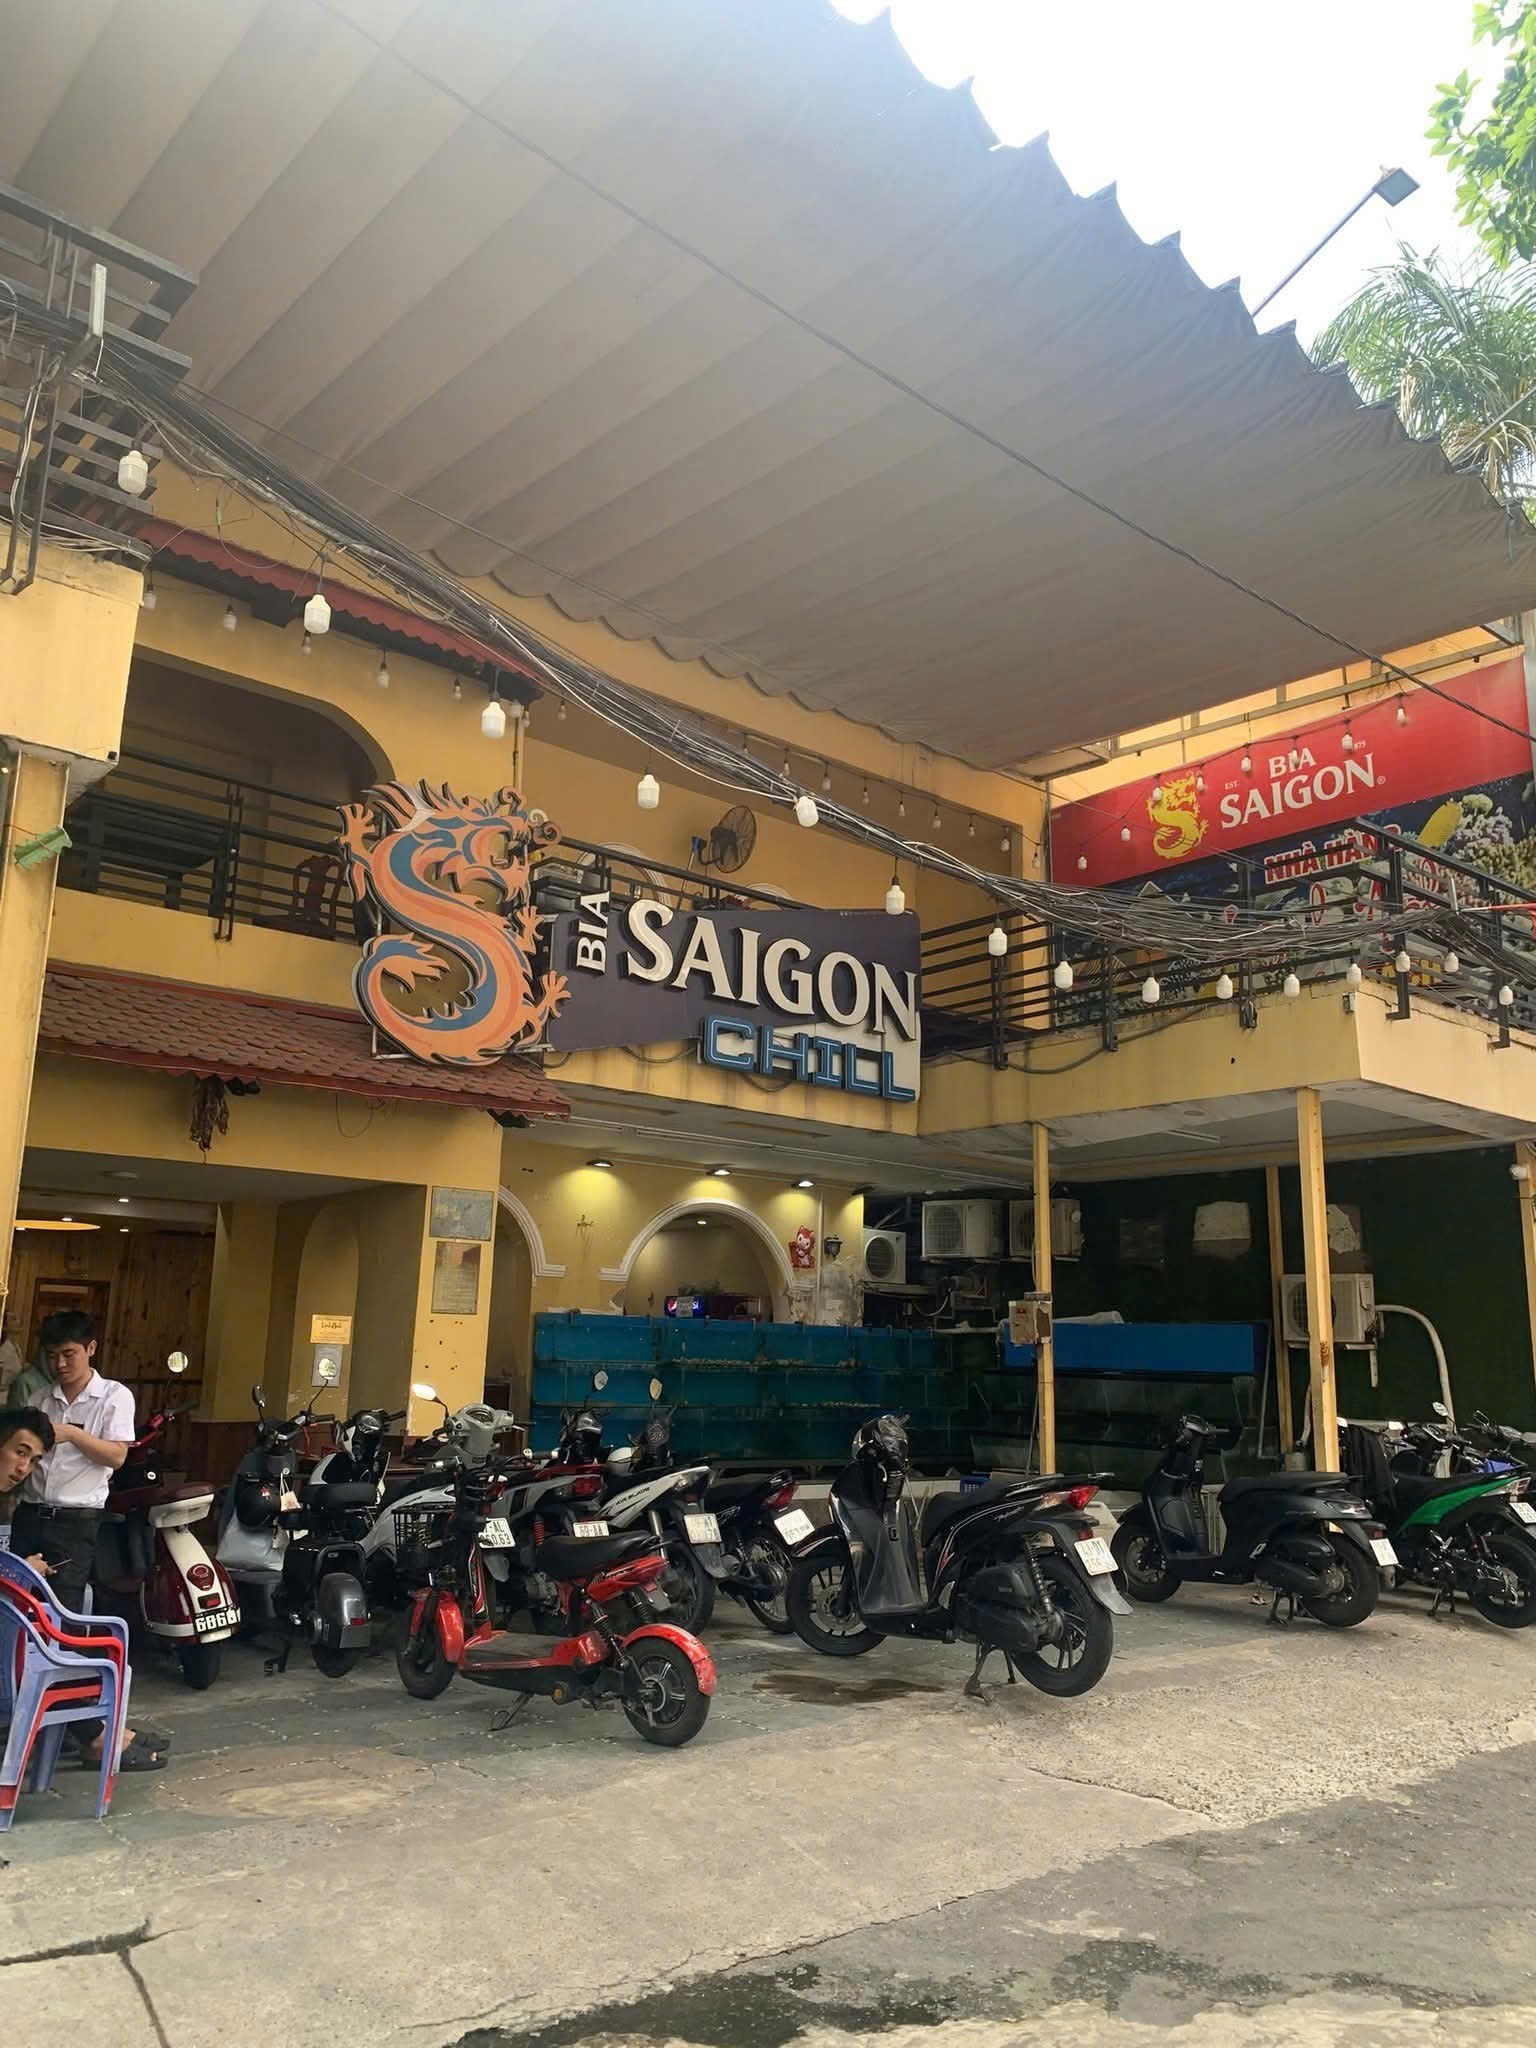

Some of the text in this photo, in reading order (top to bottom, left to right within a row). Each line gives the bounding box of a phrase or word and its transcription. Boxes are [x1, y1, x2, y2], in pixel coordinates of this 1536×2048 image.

[1219, 752, 1375, 830] SAIGON
[1268, 747, 1317, 779] BIA
[576, 890, 611, 974] BIA
[624, 897, 918, 1041] SAIGON
[703, 1013, 916, 1104] CHILL
